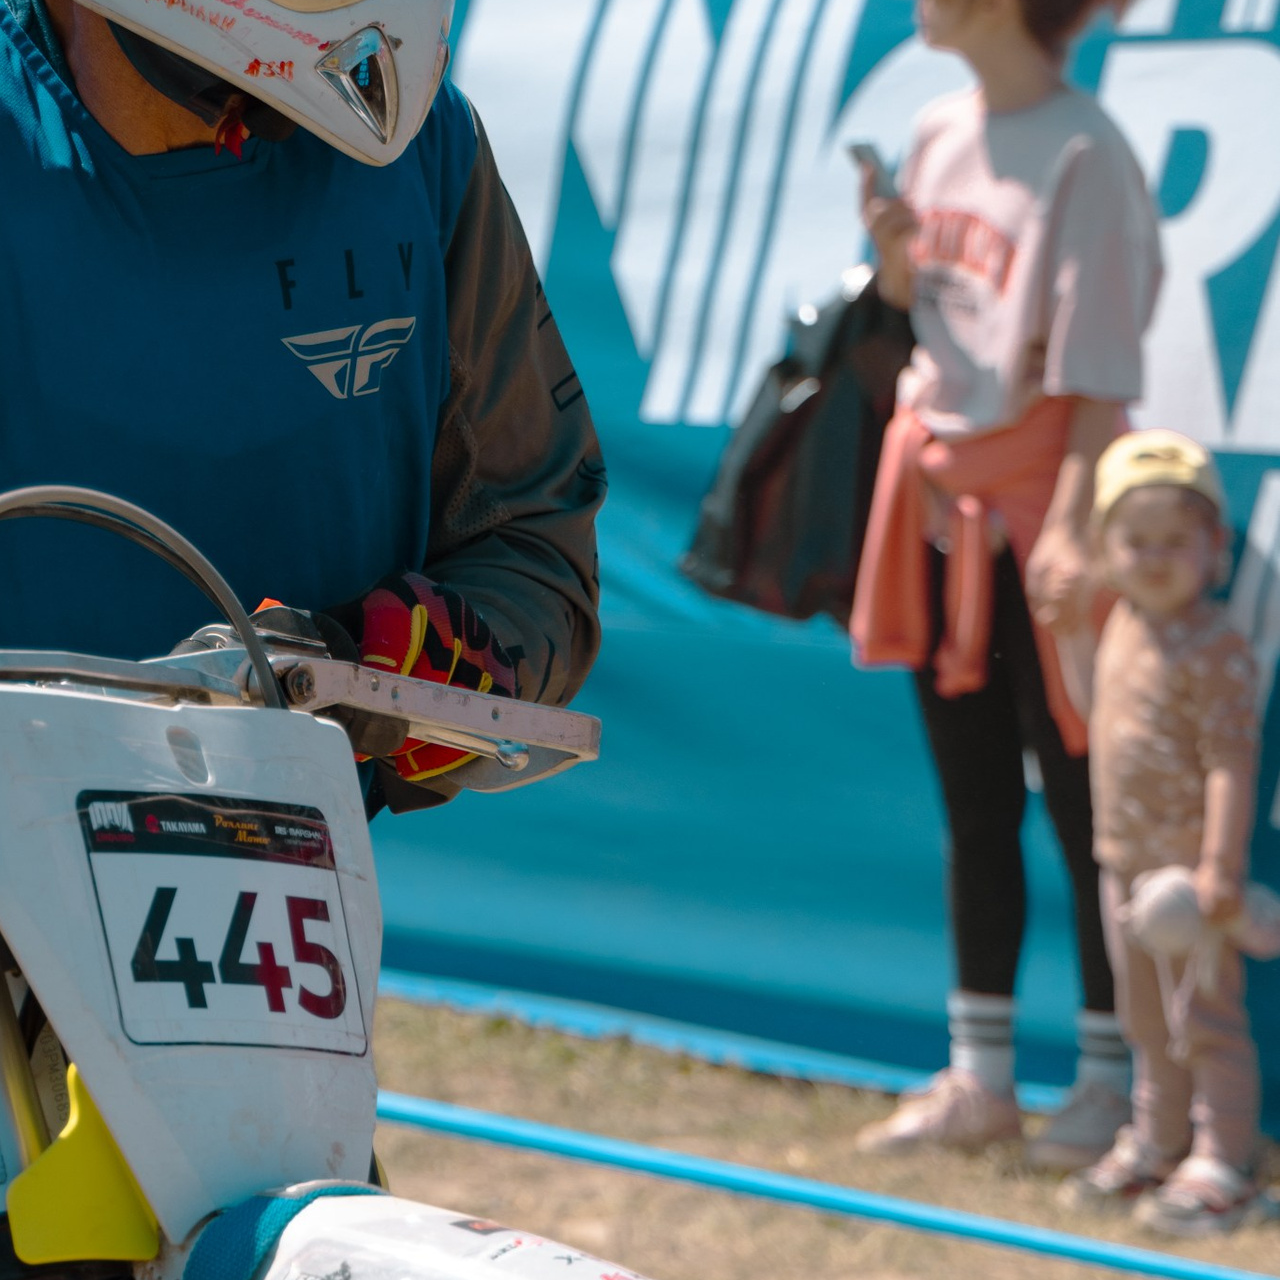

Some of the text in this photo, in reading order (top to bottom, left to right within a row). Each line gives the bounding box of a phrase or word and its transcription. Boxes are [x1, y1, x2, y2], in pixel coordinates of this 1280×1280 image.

[275, 241, 414, 311] FLY
[160, 820, 207, 835] TAKAYAMA
[130, 886, 347, 1020] 445
